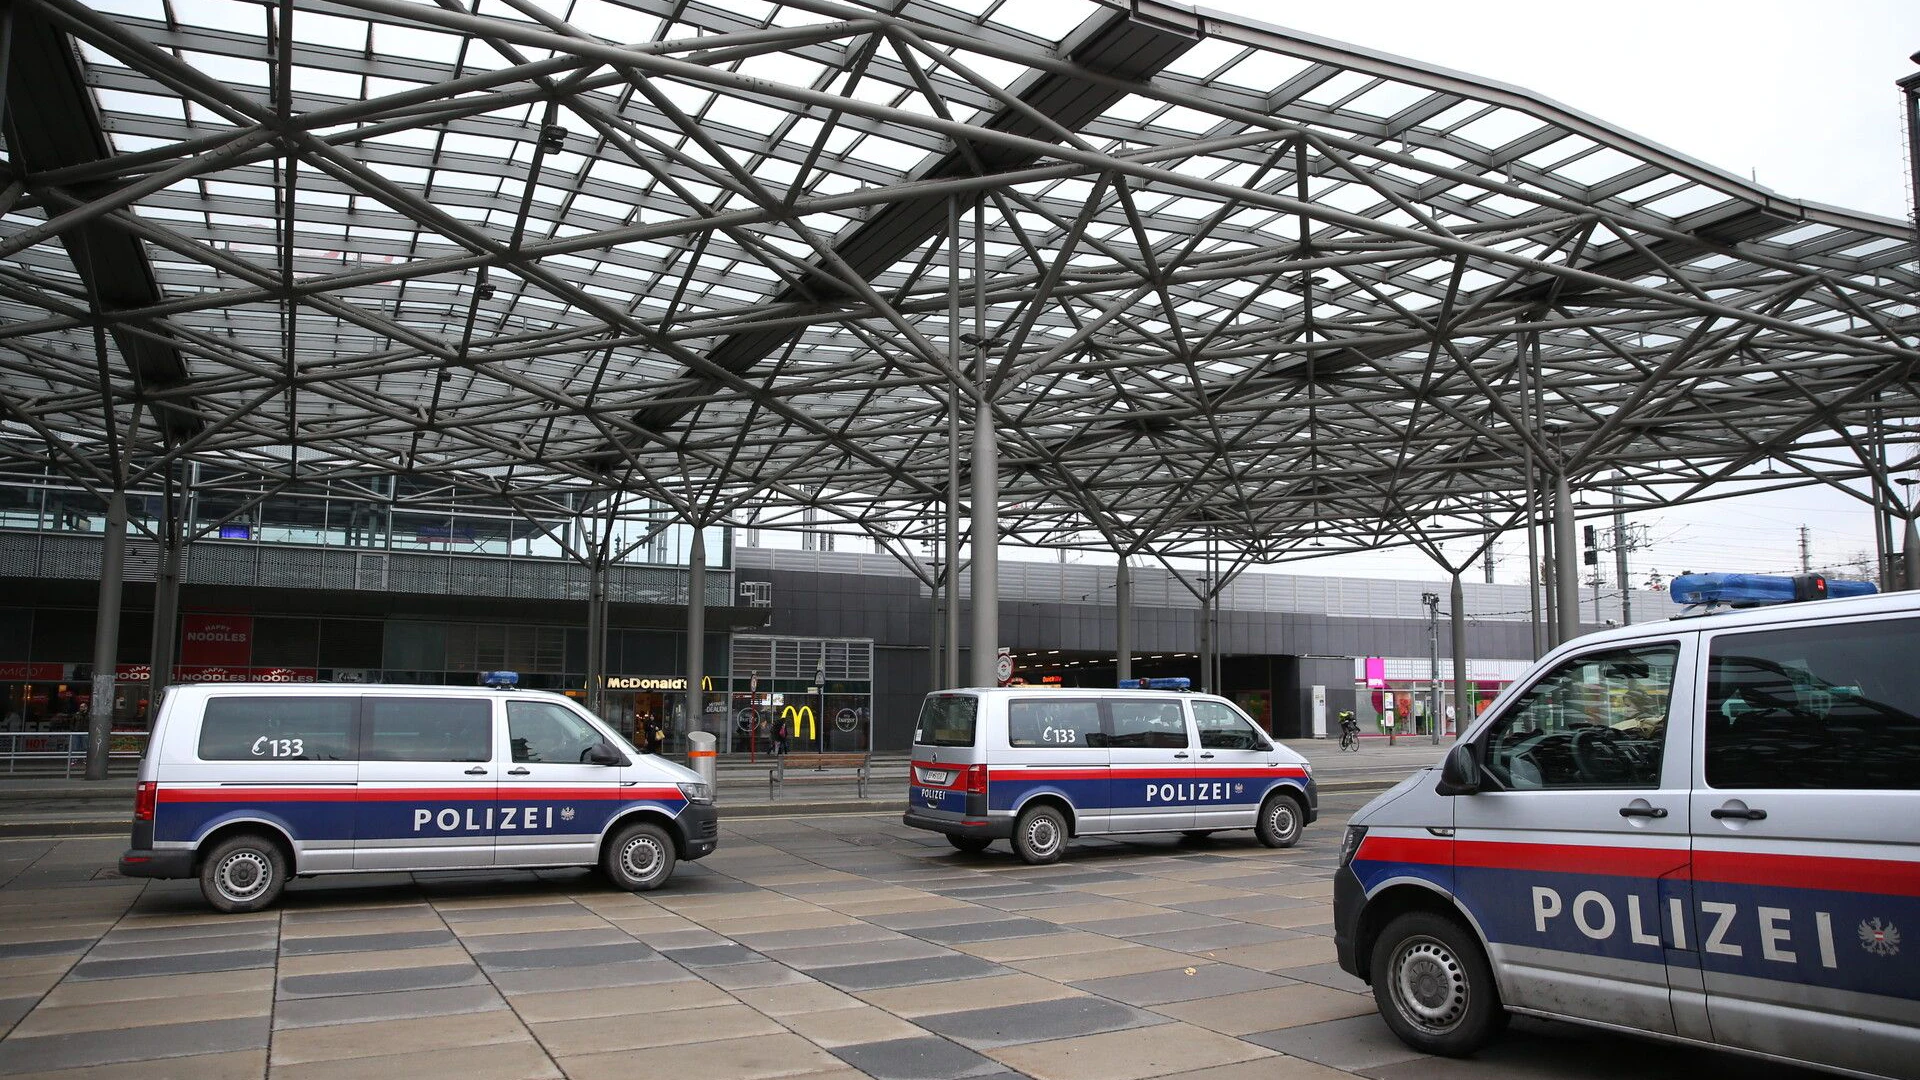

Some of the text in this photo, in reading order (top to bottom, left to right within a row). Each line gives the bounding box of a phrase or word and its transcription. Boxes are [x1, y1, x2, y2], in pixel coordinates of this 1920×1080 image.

[205, 624, 231, 632] HAPPY
[187, 632, 247, 642] NOODLES
[202, 667, 229, 675] HAPPY
[270, 668, 297, 676] HAPPY
[182, 674, 246, 682] NOODLES
[252, 675, 314, 683] NOODLES
[1053, 728, 1076, 744] 133
[269, 738, 304, 757] 133
[921, 788, 946, 803] POLIZEI
[1145, 783, 1231, 802] POLIZEI
[414, 807, 553, 831] POLIZEI
[1532, 886, 1838, 969] POLIZEI
